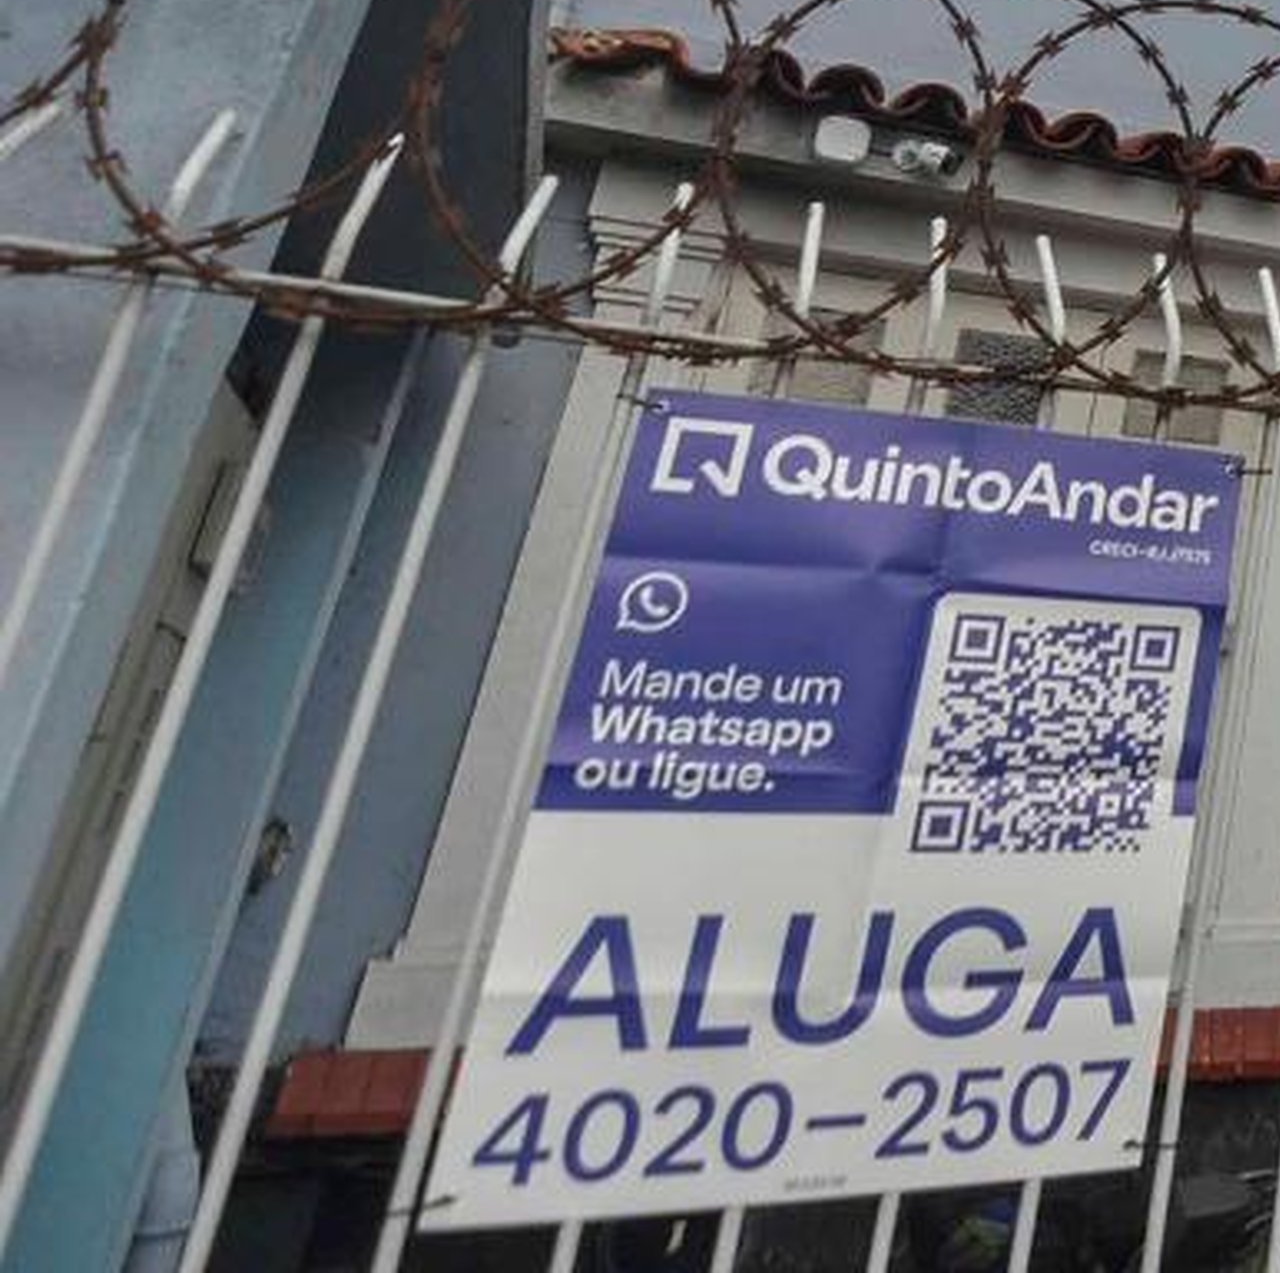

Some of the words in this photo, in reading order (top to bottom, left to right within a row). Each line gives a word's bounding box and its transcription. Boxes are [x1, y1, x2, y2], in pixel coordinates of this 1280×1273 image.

[763, 434, 1219, 533] QuintoAndar
[599, 659, 762, 704] Mande
[770, 674, 842, 705] um
[591, 703, 833, 755] Whatsapp
[575, 756, 638, 789] ou
[648, 749, 779, 800] ligue.
[504, 907, 1137, 1057] ALUGA
[473, 1059, 1132, 1187] 4020-2507
